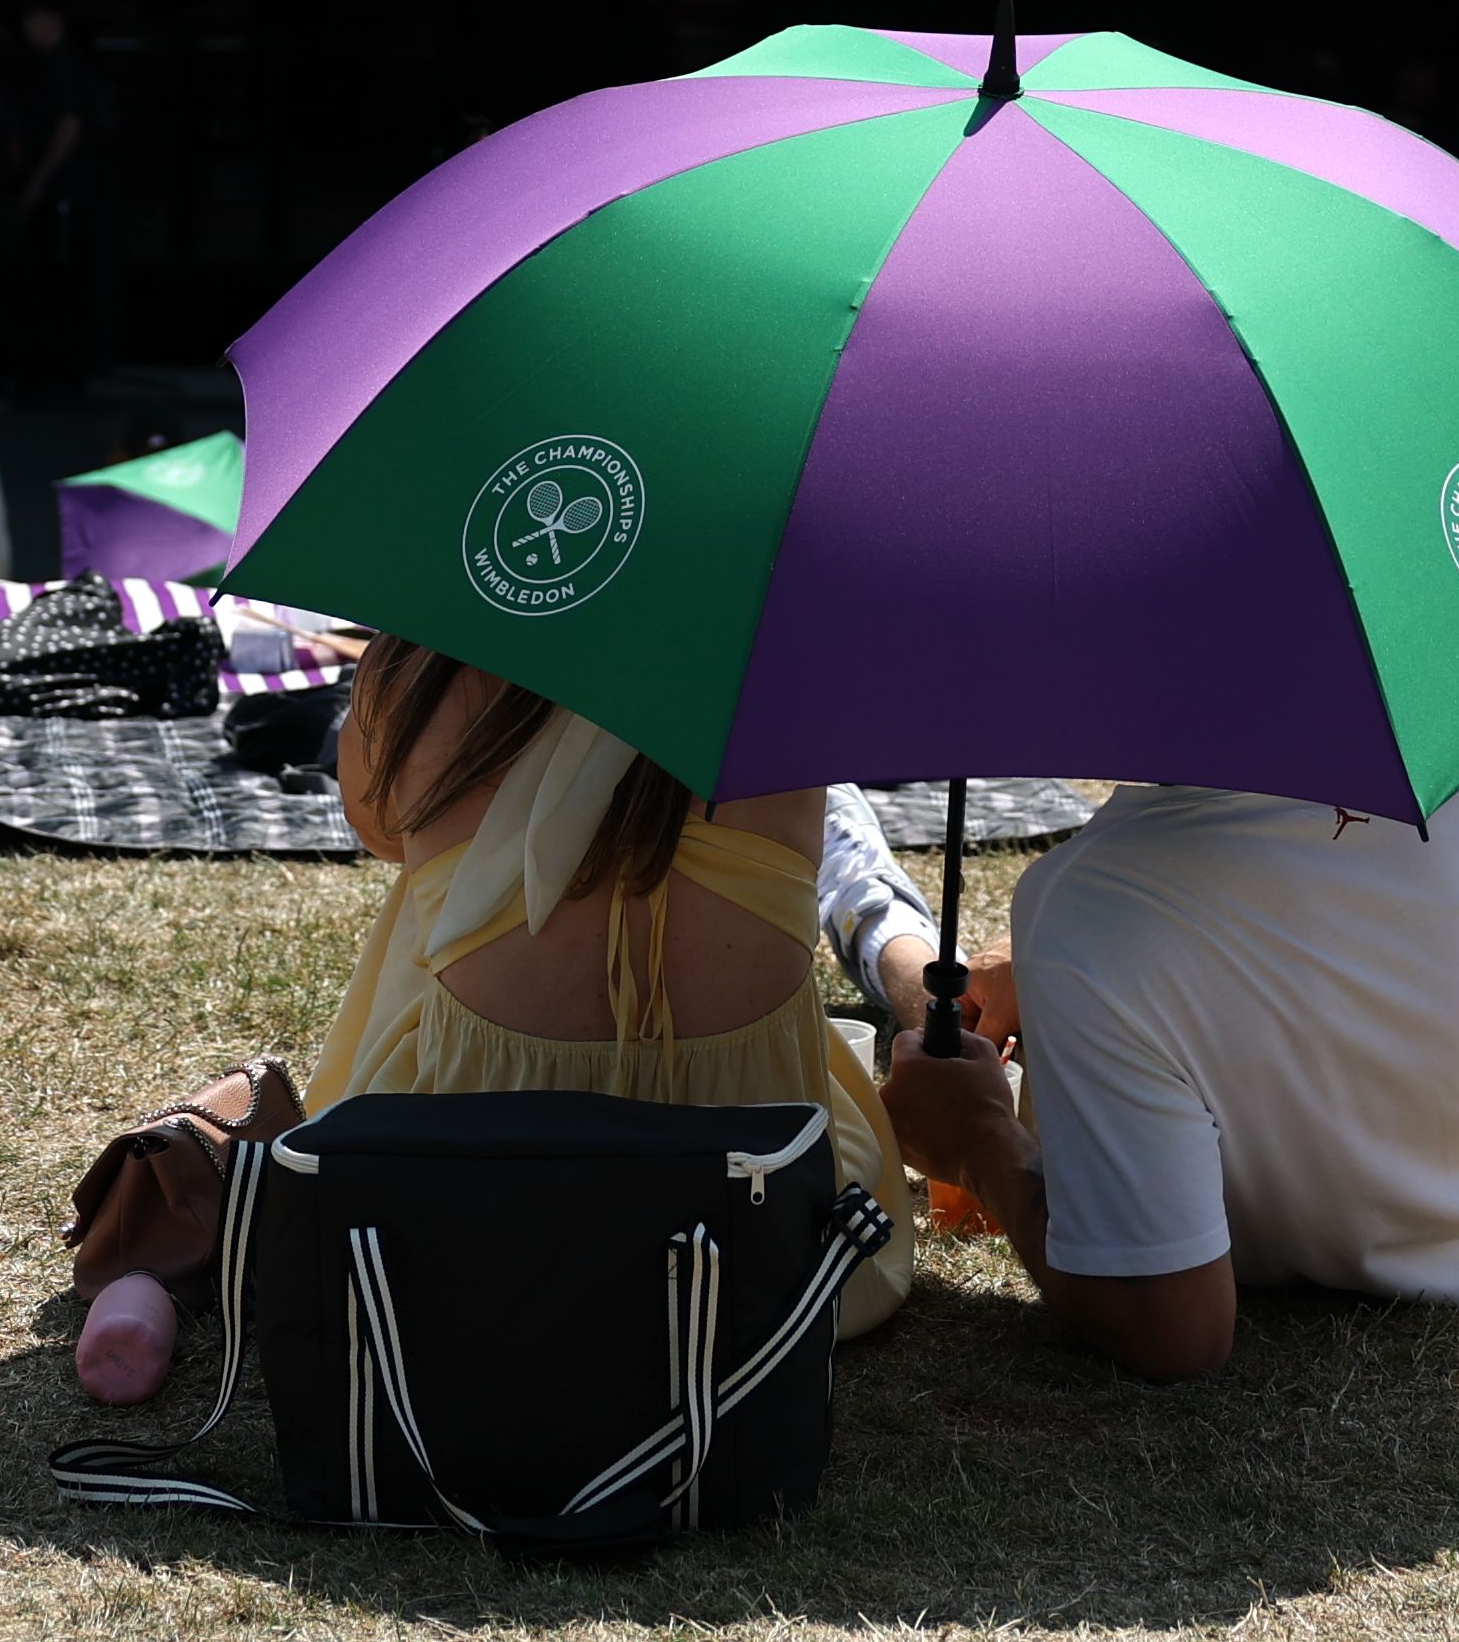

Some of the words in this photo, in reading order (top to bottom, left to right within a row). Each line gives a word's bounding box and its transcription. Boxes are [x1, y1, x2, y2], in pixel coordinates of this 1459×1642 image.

[492, 460, 530, 496] THE
[534, 445, 635, 544] CHAMPIONSHIPS
[474, 547, 575, 605] WIMBLEDON
